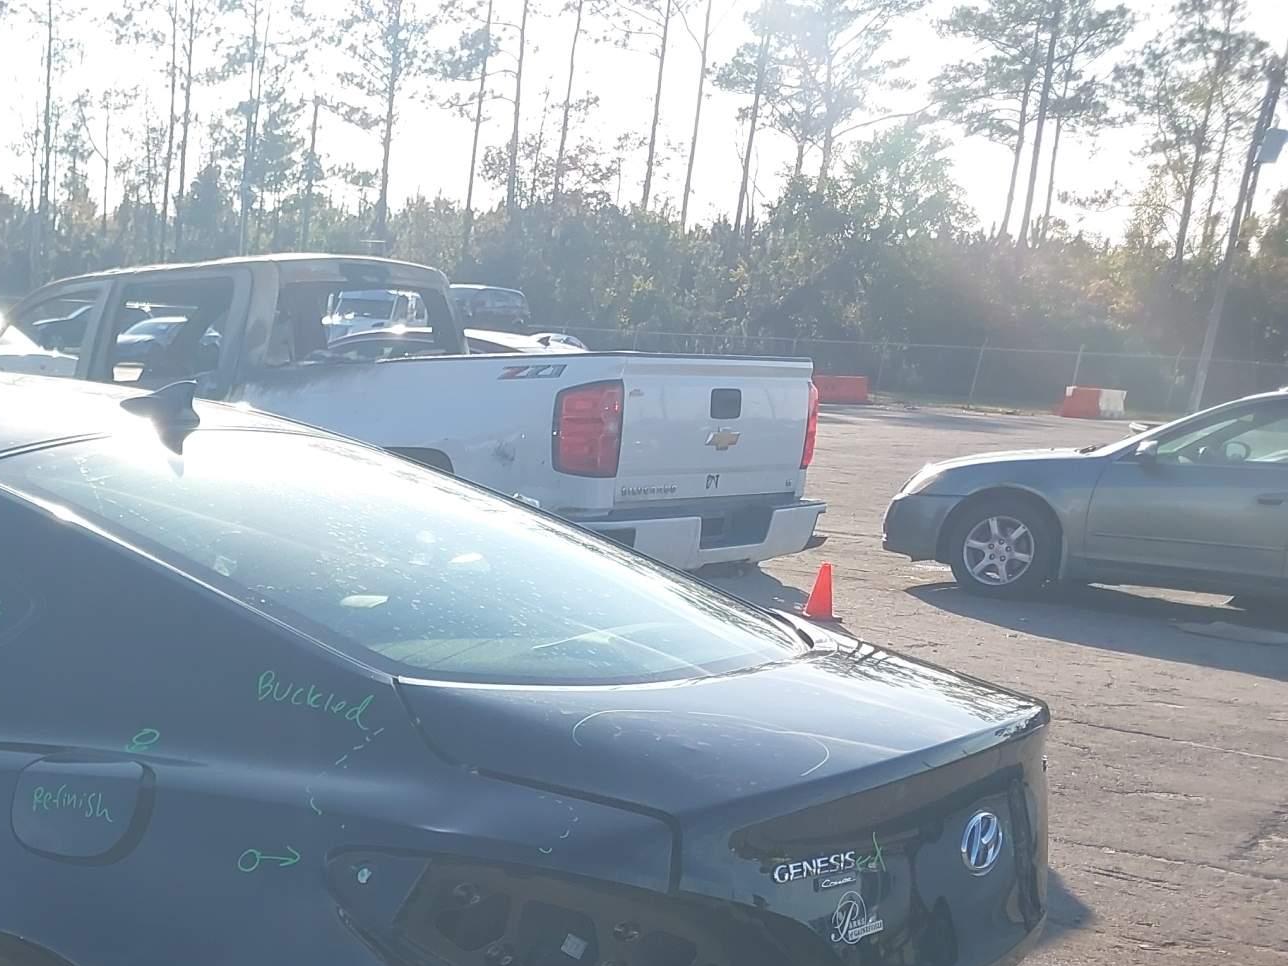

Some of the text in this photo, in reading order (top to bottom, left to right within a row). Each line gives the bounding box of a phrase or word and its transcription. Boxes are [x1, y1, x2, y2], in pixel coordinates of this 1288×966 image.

[497, 364, 568, 380] Z71
[32, 784, 114, 822] Refinish
[773, 851, 856, 883] GENESIS
